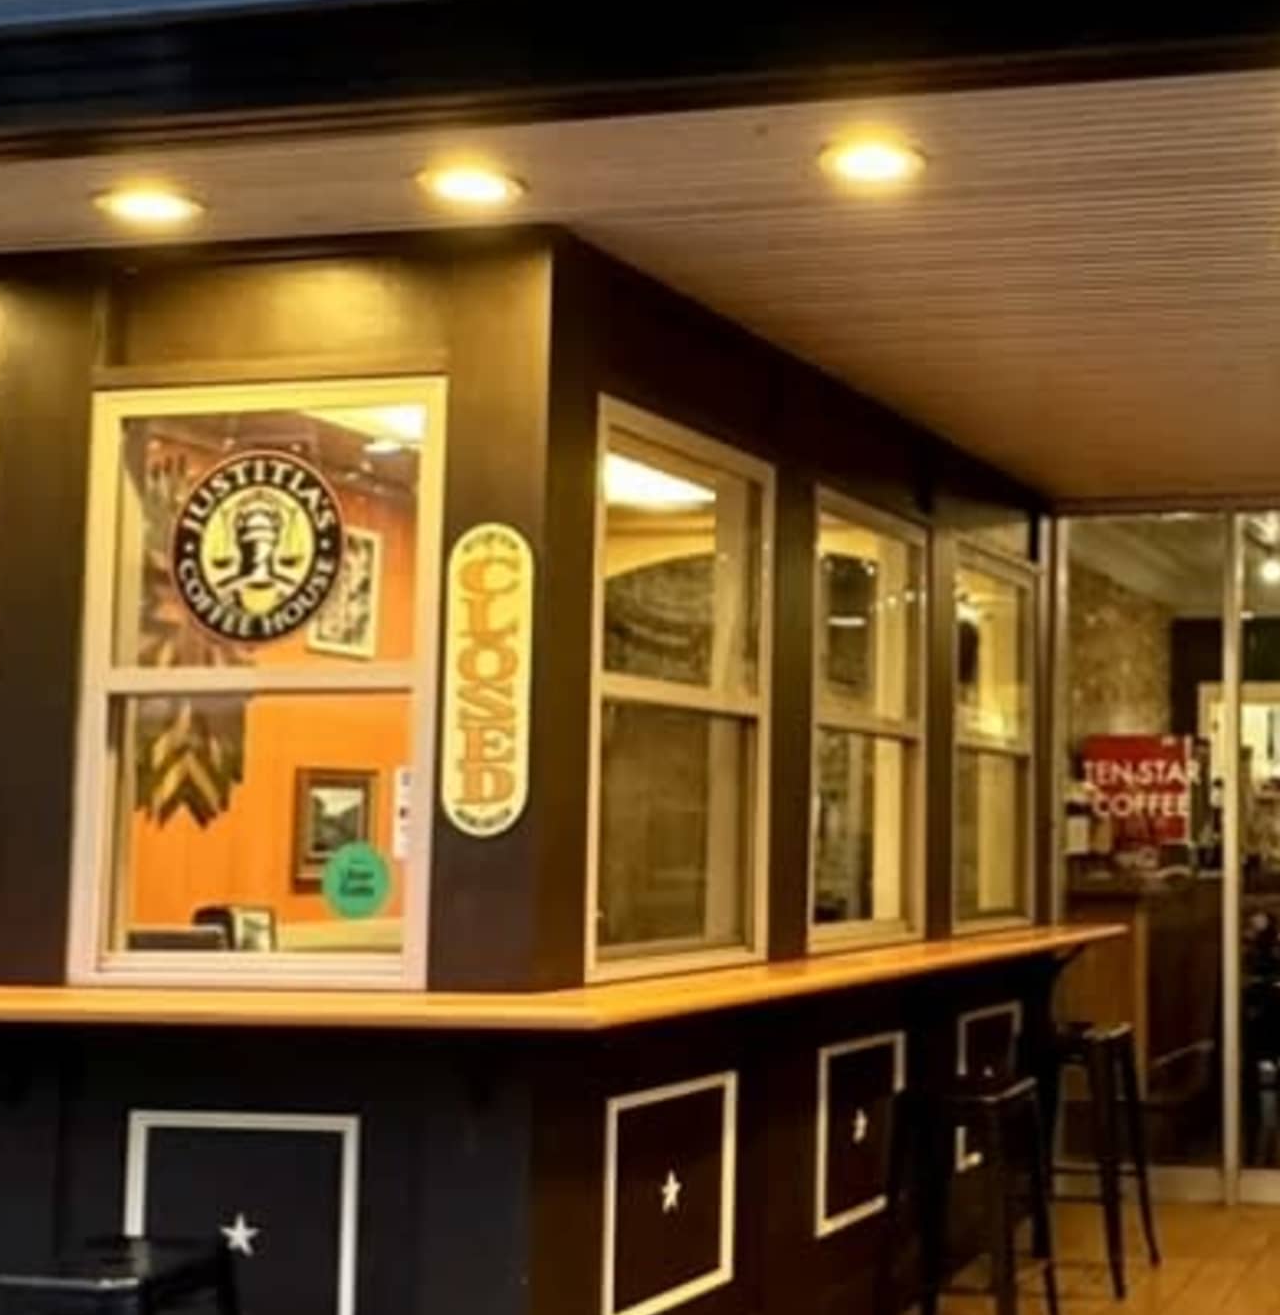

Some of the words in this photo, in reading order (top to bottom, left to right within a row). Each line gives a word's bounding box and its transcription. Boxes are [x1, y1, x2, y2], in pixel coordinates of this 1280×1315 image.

[178, 559, 251, 637] COFFEE
[454, 557, 522, 805] CLOSED
[1093, 791, 1189, 817] COFFEE
